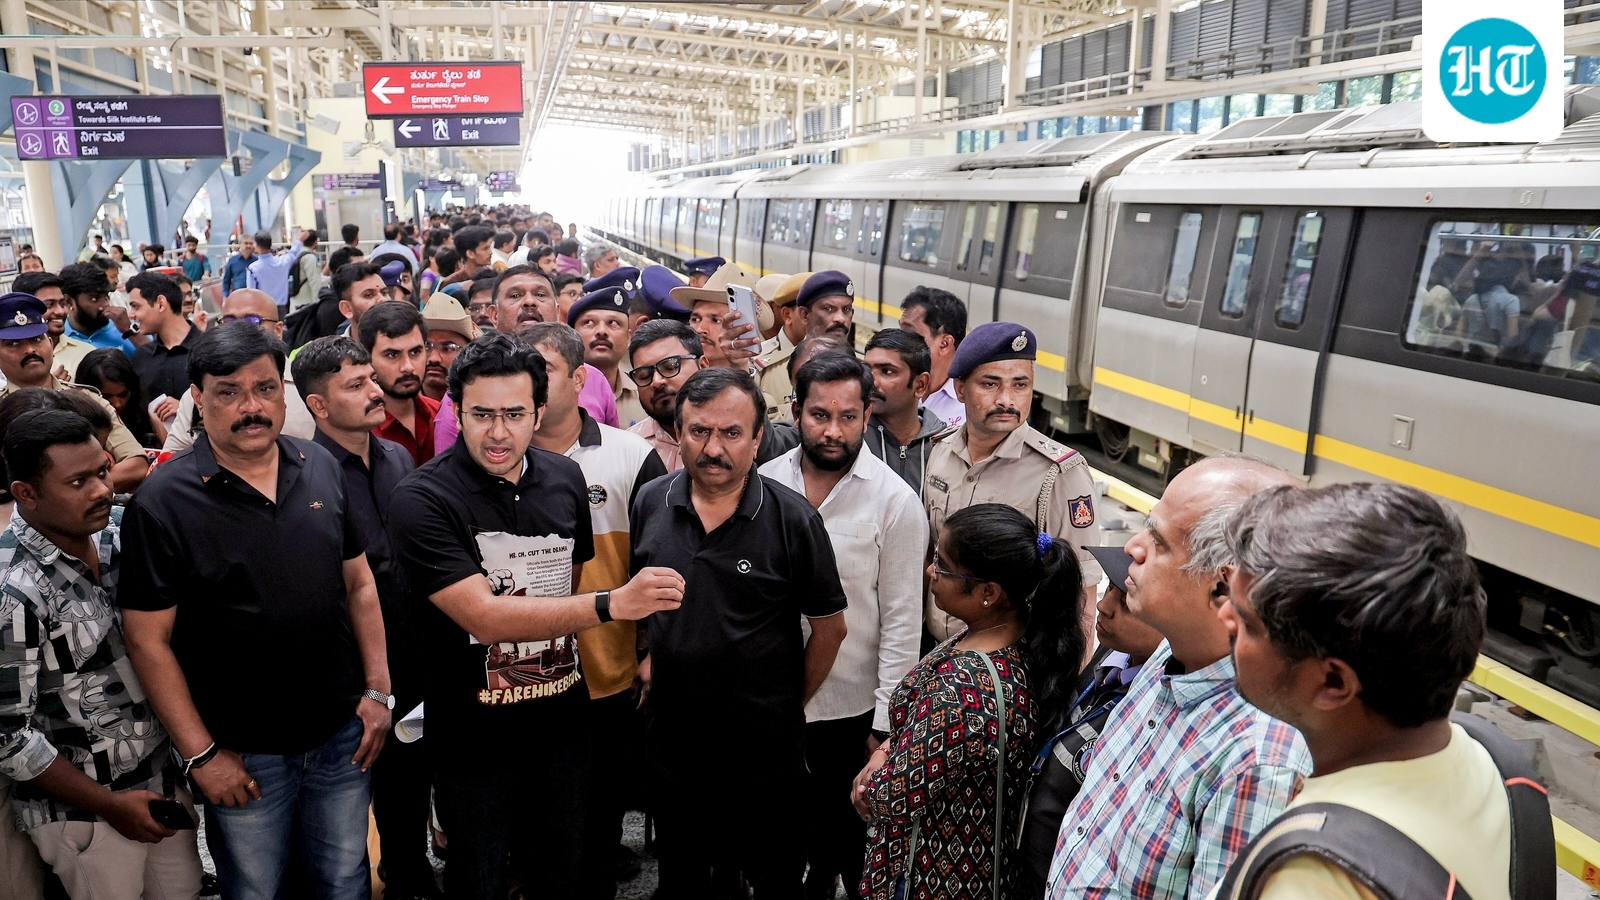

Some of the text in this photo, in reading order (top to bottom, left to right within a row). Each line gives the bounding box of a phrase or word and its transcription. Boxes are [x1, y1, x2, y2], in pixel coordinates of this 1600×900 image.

[411, 94, 489, 105] Emergency Train Stop
[461, 129, 479, 140] Exit
[81, 146, 99, 155] Exit
